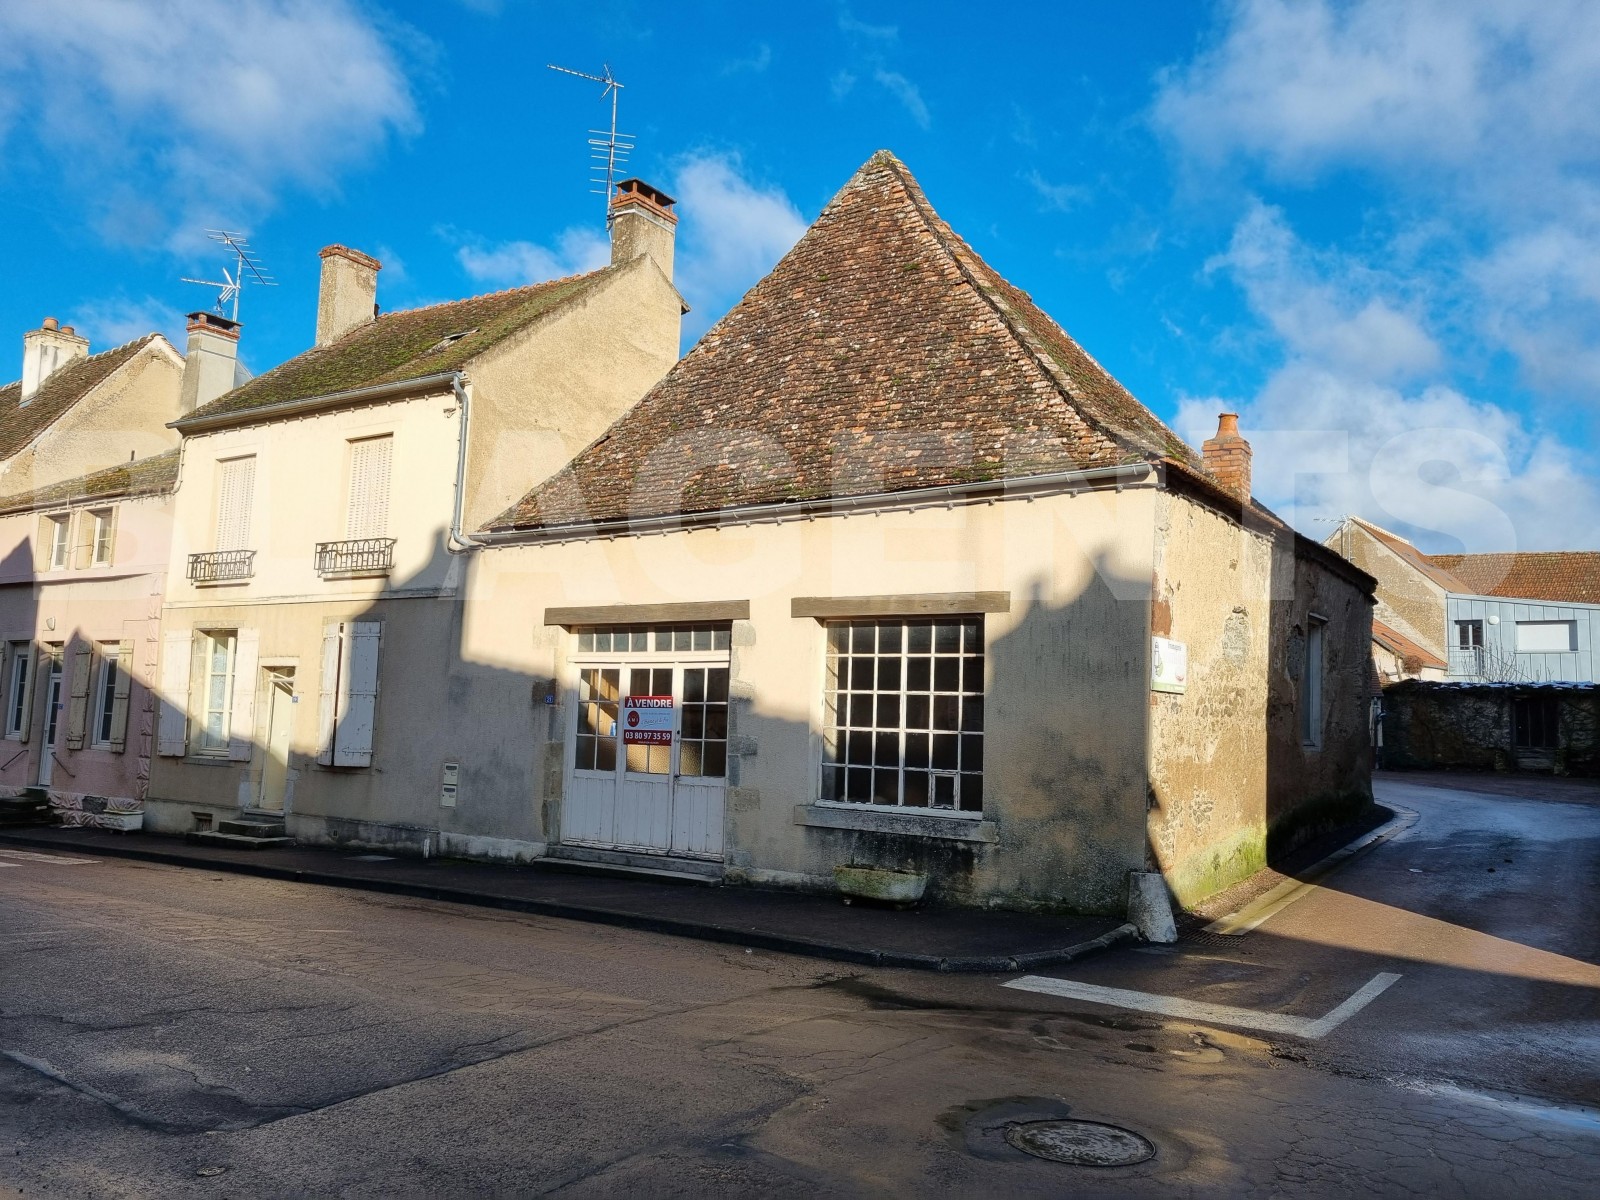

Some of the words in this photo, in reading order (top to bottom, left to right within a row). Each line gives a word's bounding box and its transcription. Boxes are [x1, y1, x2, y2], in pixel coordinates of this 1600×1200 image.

[627, 697, 634, 708] À
[635, 699, 672, 708] VENDRE
[625, 731, 634, 739] 03
[643, 732, 652, 740] 97
[652, 732, 661, 740] 35
